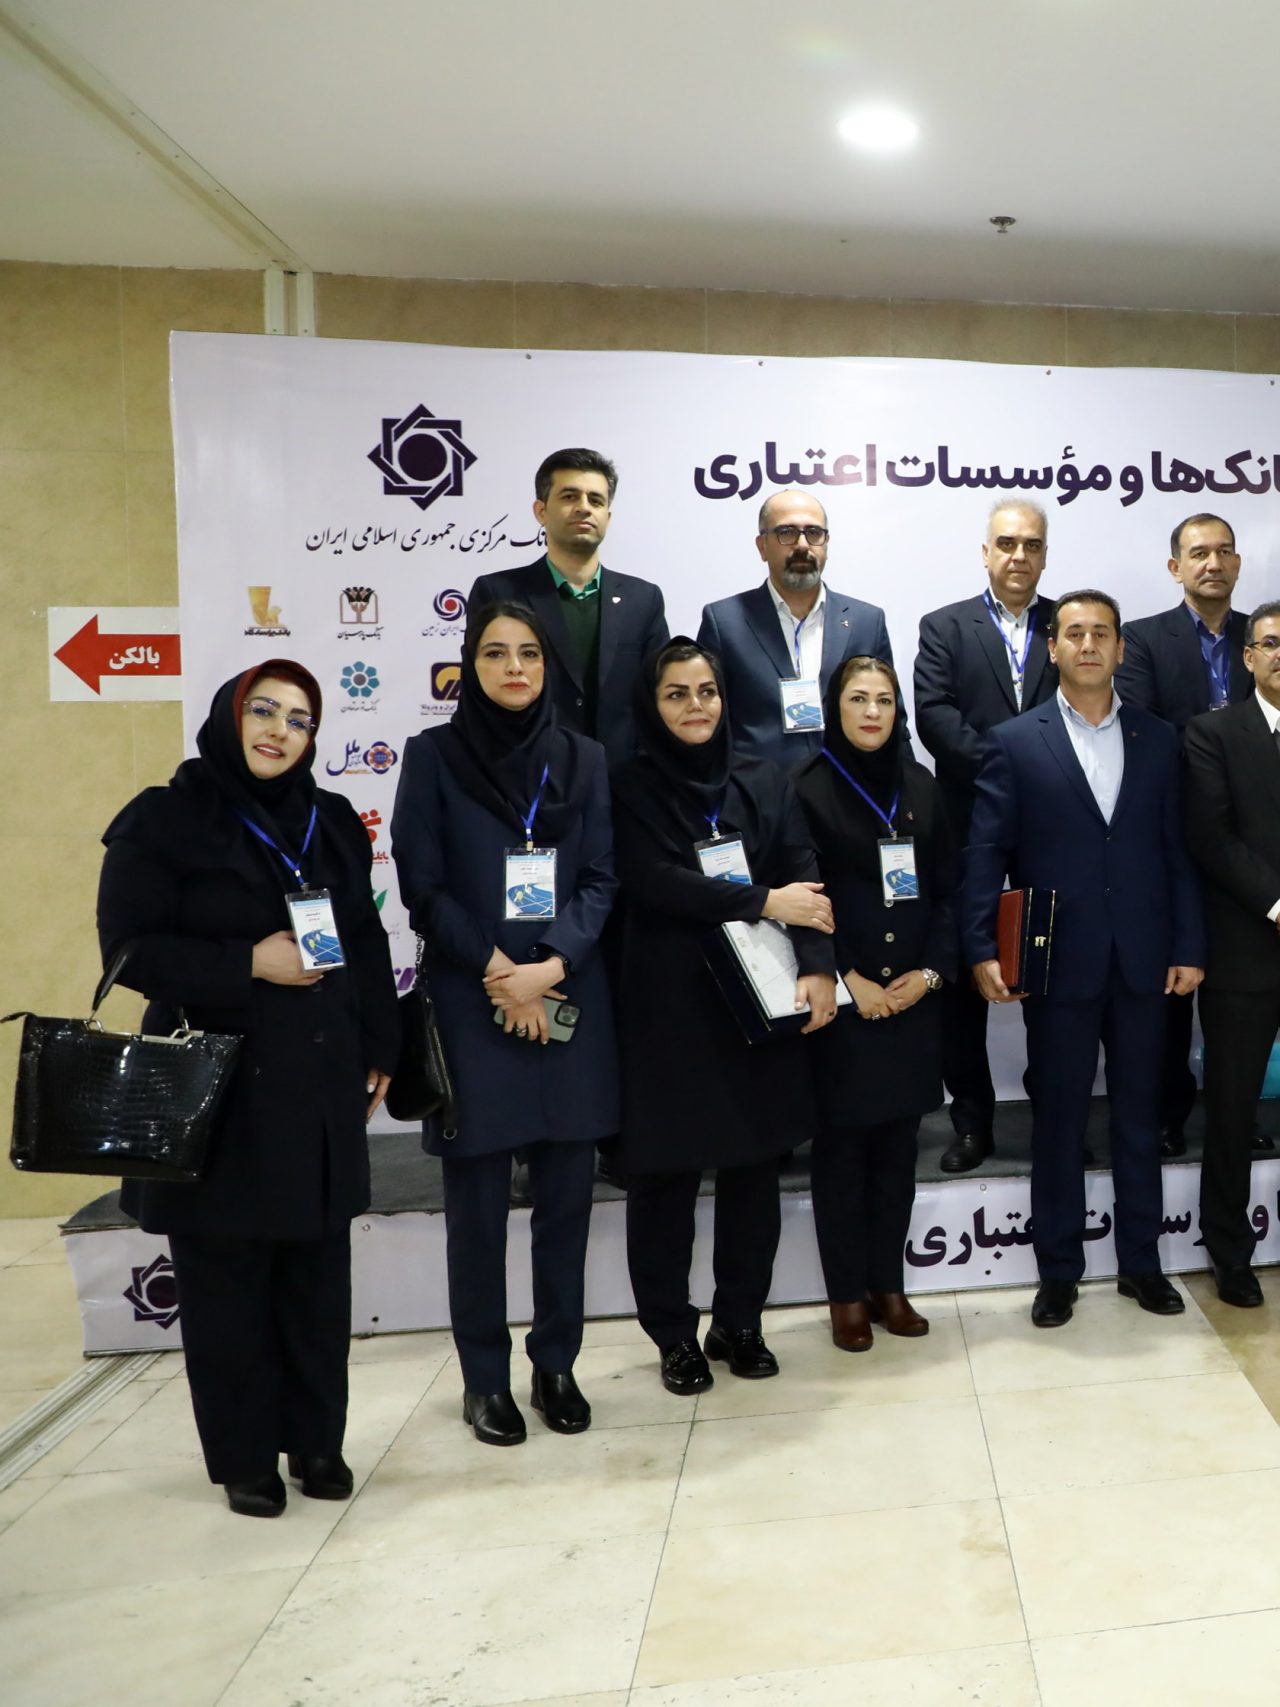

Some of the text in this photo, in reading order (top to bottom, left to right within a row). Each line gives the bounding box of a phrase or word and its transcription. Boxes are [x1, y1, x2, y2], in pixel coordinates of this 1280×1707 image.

[693, 441, 877, 501] اعتباری
[885, 445, 1112, 506] مؤسسات
[1120, 465, 1144, 507] و
[306, 514, 548, 554] انک مرکزی جمهوری اسلامی ایران
[108, 645, 161, 670] بالکن
[905, 1206, 1034, 1267] تباری
